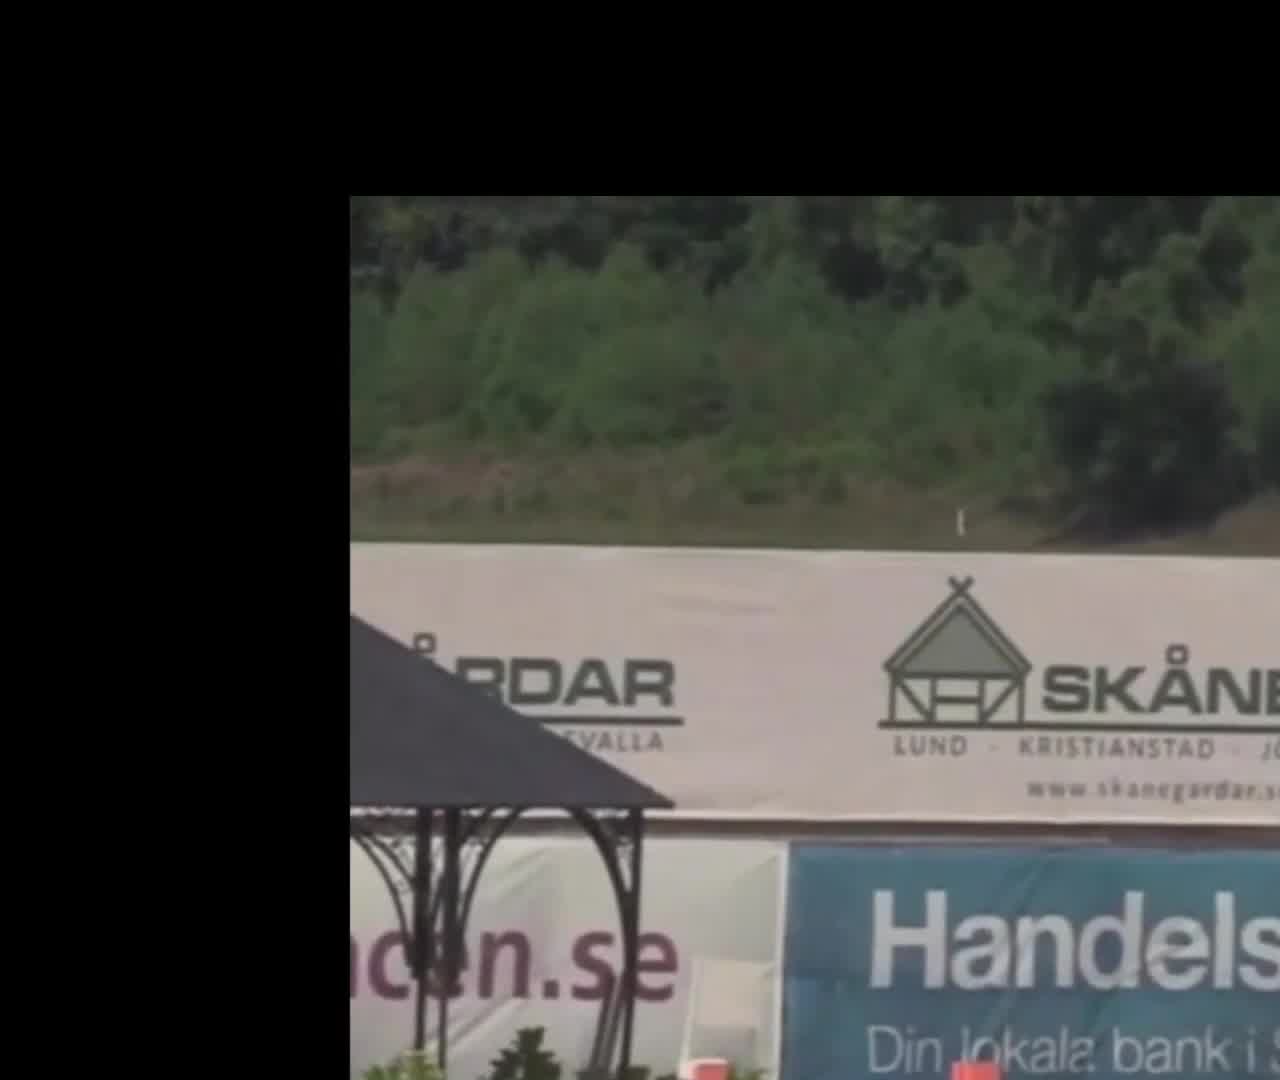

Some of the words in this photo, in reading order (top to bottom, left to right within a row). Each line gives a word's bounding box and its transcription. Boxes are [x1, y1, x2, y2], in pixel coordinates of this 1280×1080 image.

[413, 631, 675, 706] RDAR
[894, 735, 967, 757] LUND
[1018, 736, 1216, 760] KRISTIANSTAD
[866, 1025, 943, 1074] Din
[960, 1025, 1098, 1074] lokala
[1112, 1025, 1233, 1074] bank
[1247, 1026, 1256, 1074] i
